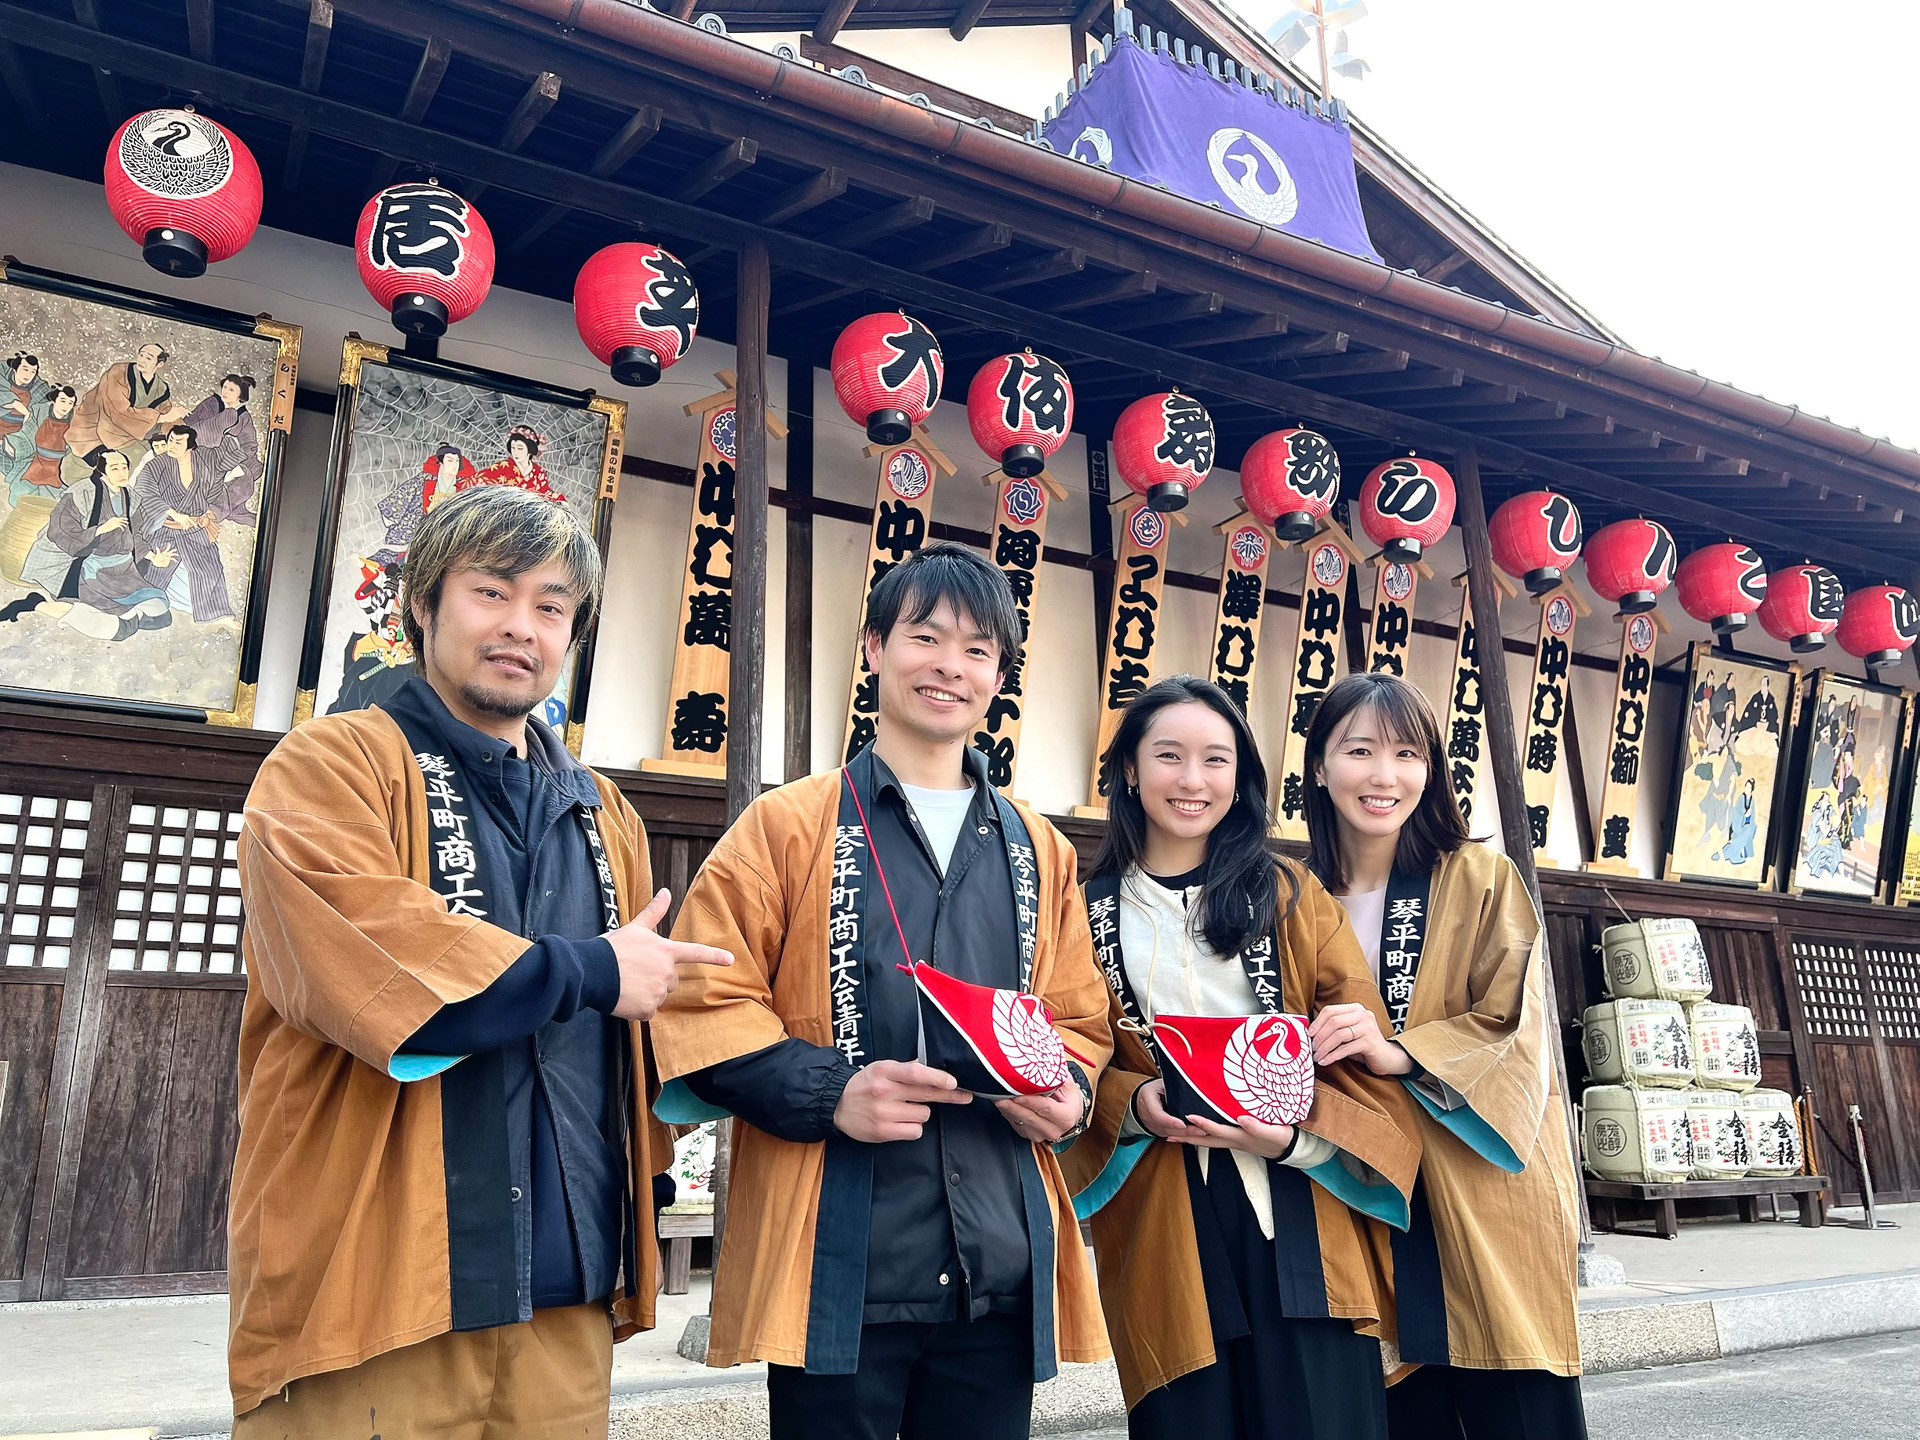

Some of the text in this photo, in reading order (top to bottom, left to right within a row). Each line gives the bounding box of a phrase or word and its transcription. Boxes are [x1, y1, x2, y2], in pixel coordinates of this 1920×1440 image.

[877, 313, 944, 411] 大
[1733, 546, 1766, 600] こ
[830, 825, 865, 1068] 琴平町商工会青年
[1008, 841, 1038, 994] 琴平町商工
